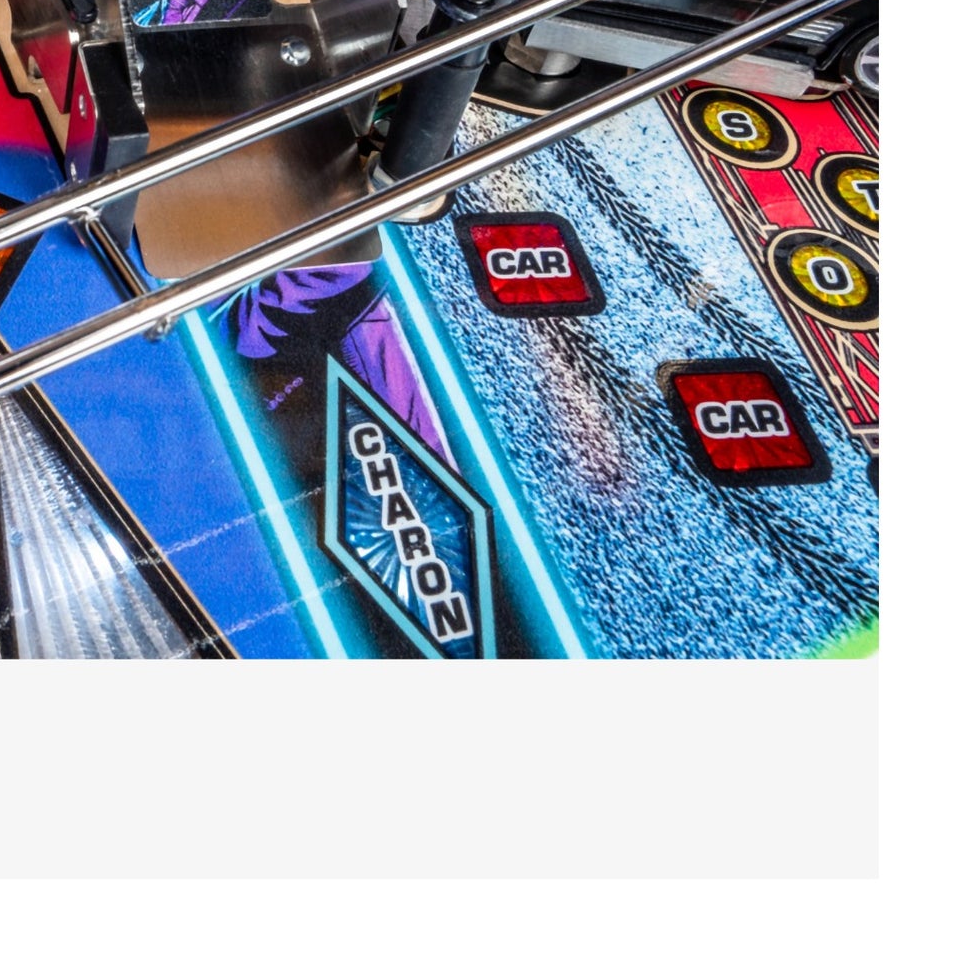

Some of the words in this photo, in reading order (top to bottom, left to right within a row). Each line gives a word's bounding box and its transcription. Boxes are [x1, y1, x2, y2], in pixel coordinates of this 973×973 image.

[721, 112, 755, 139] S
[490, 250, 568, 276] CAR
[699, 402, 785, 435] CAR
[352, 425, 470, 639] CHARON
